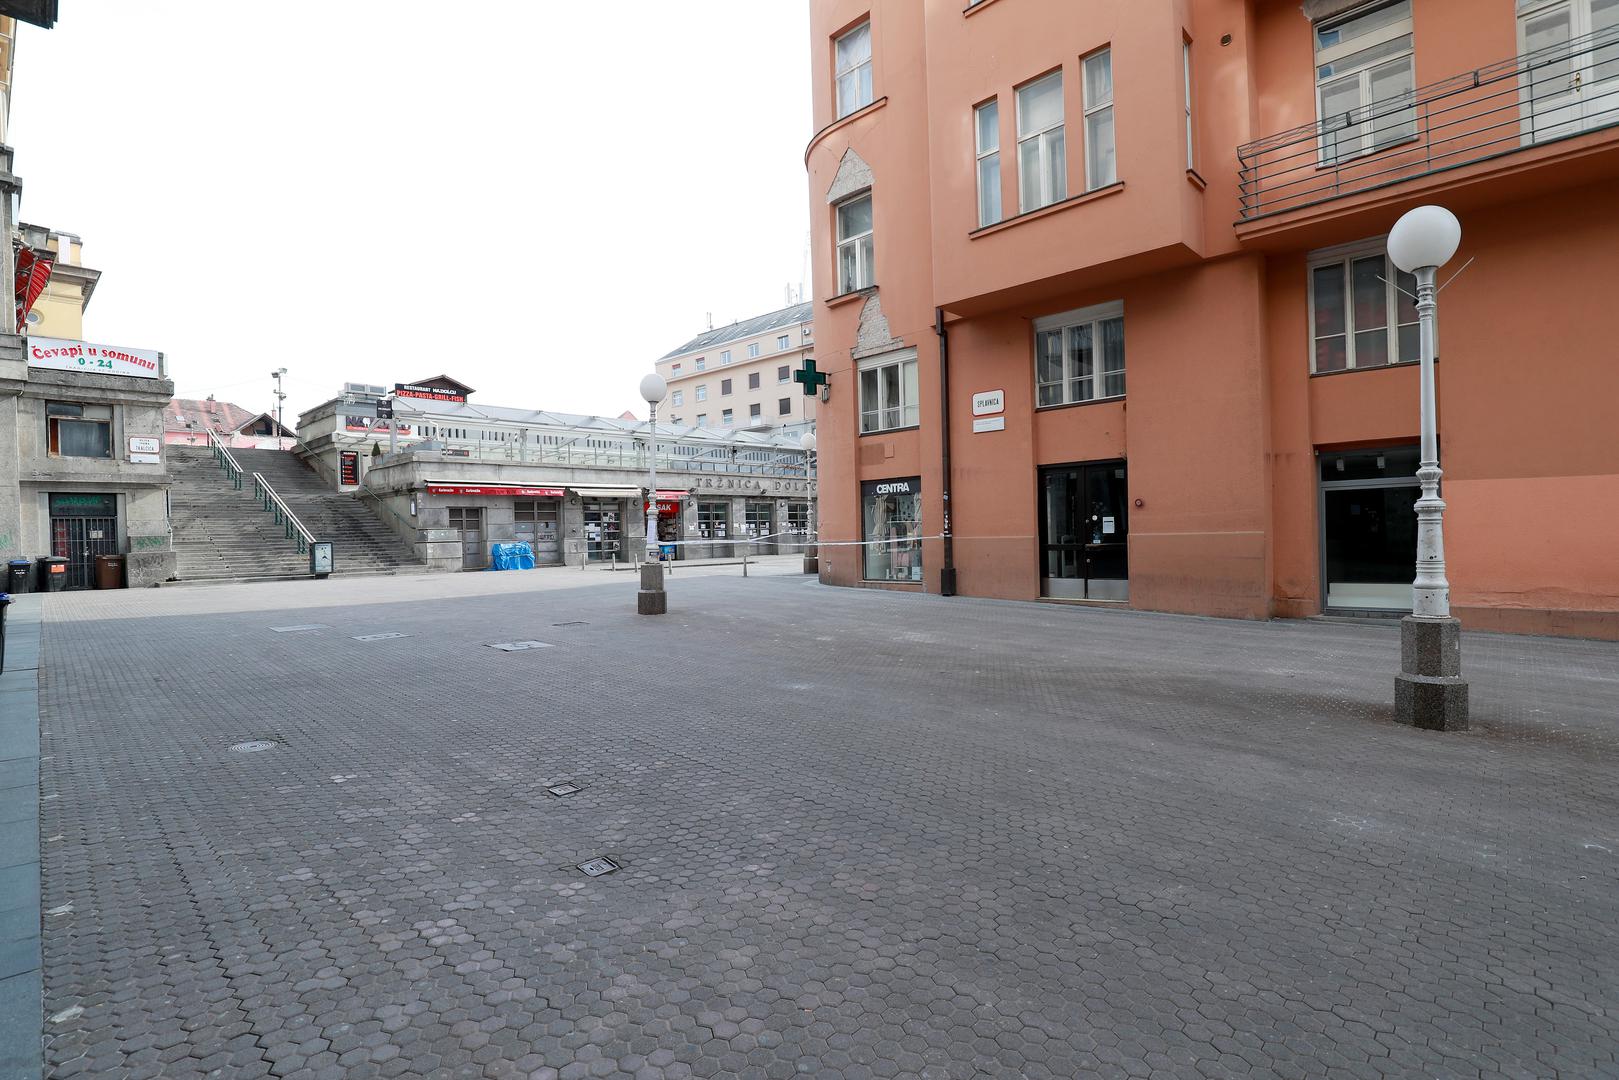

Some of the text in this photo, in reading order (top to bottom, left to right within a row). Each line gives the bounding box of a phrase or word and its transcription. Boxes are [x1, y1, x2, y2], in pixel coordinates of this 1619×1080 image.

[31, 345, 156, 370] Čevapi u somunu
[78, 358, 86, 366] 0
[97, 359, 113, 369] 24
[404, 384, 431, 393] RESTAURANT
[976, 398, 999, 408] SPLAVNICA
[695, 477, 817, 491] TRŽNICA DOLAC
[876, 482, 910, 494] CENTRA
[657, 503, 672, 511] SAK
